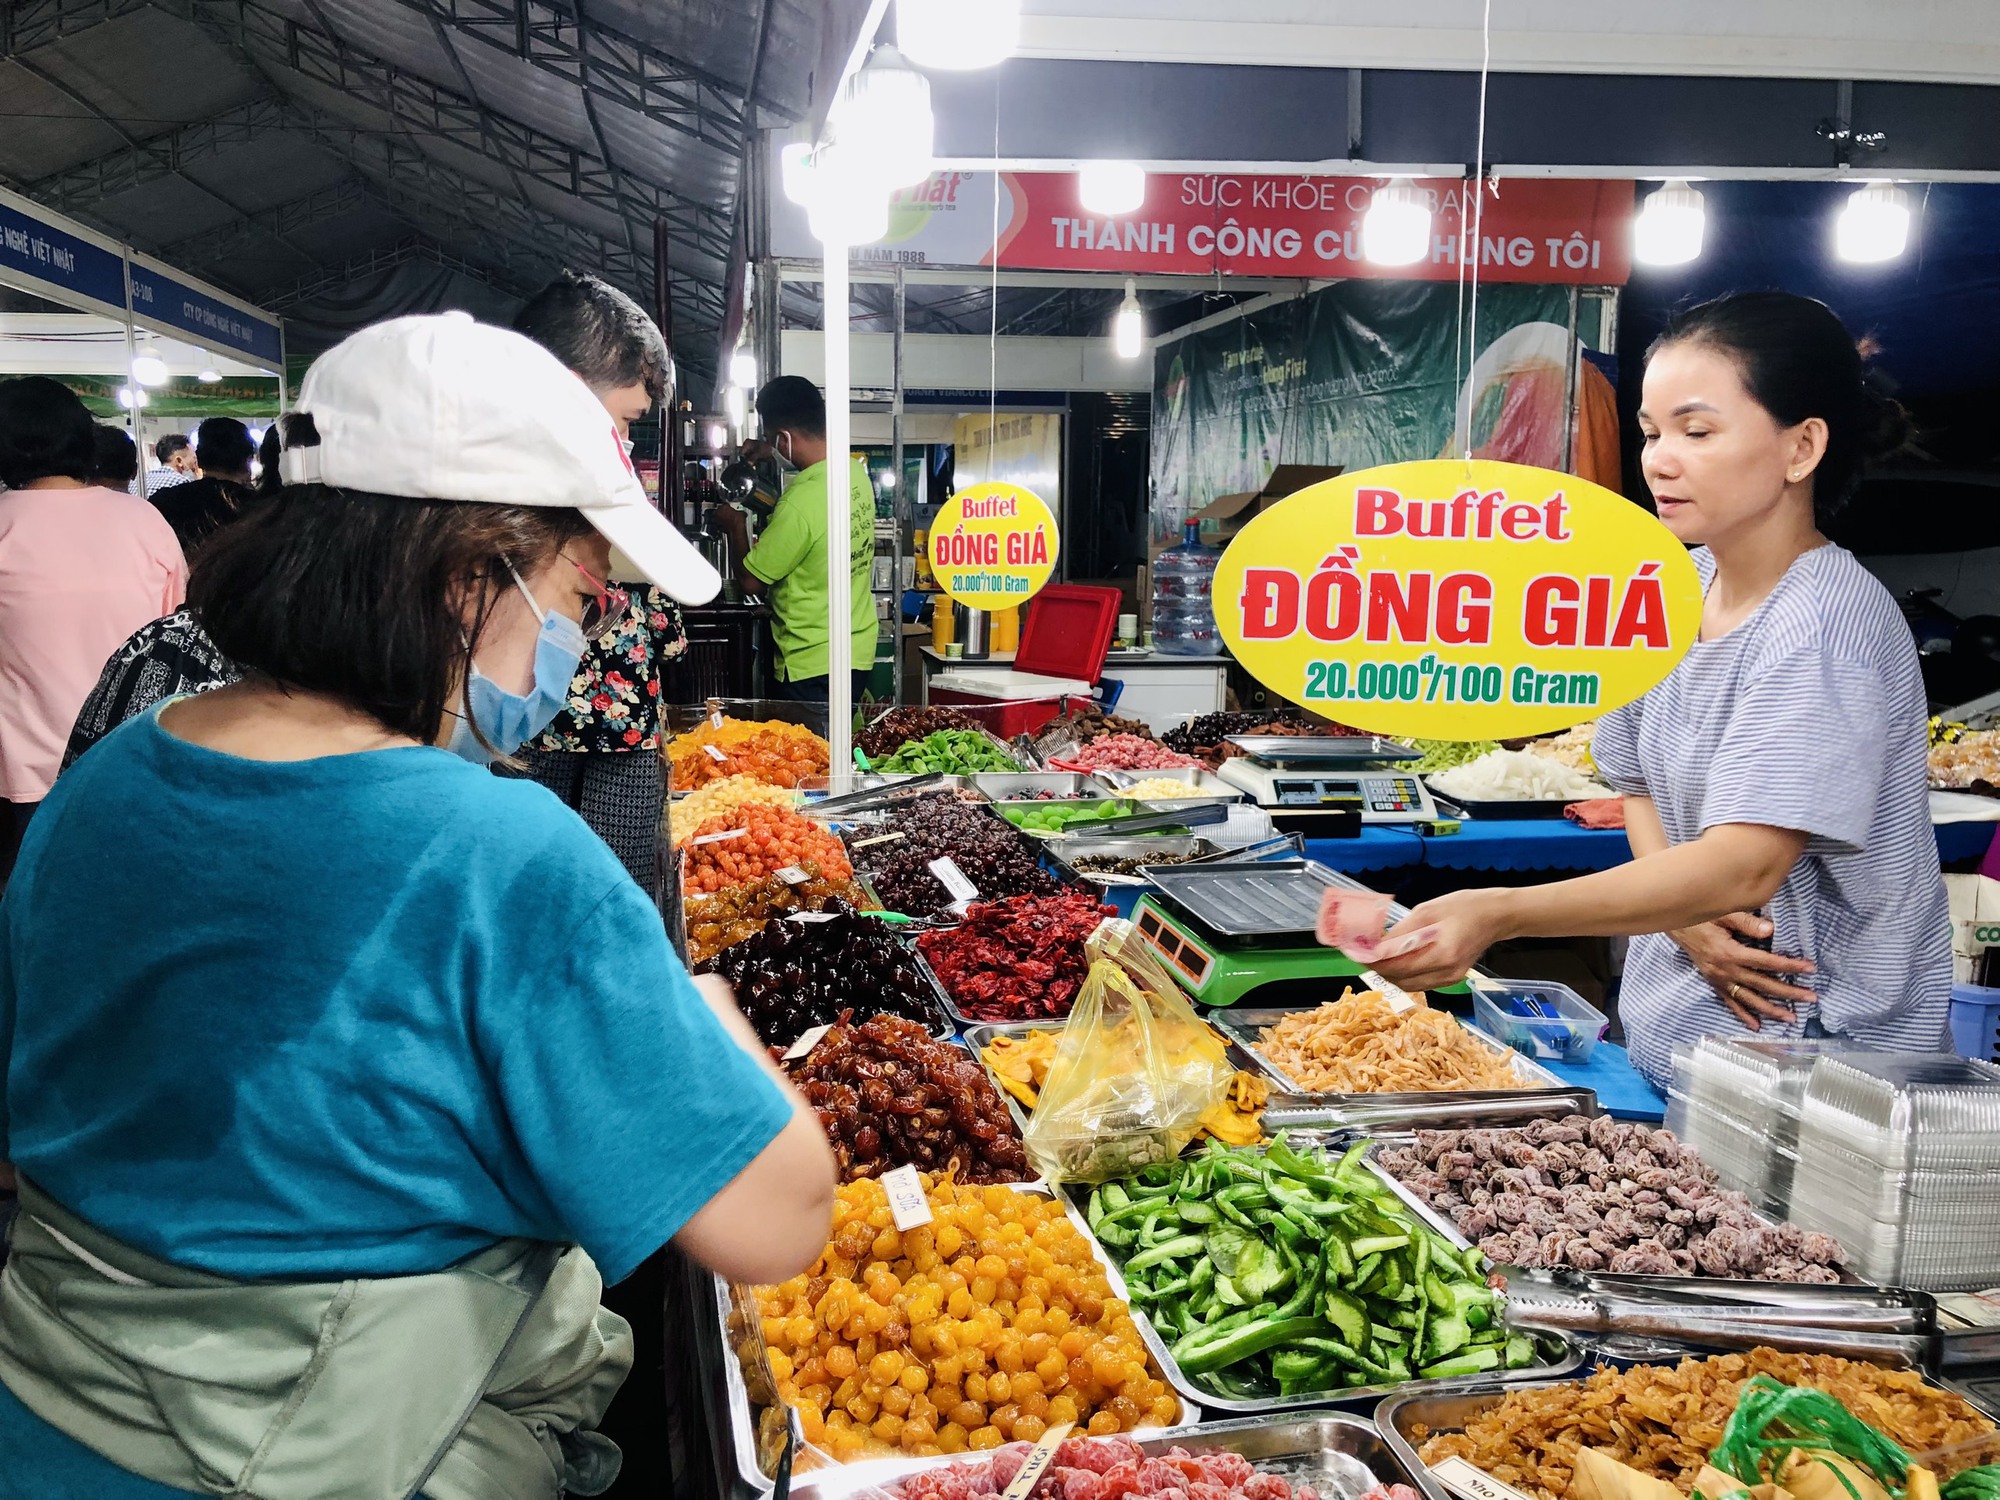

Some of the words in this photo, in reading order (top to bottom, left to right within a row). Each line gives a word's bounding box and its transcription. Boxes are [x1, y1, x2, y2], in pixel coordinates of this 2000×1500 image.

[1252, 175, 1335, 211] KHỎE
[4, 226, 30, 260] NGHỆ
[31, 237, 51, 267] VIỆT
[52, 246, 75, 276] NHẬT
[896, 250, 926, 263] 1988
[1187, 217, 1302, 260] CÔNG
[1431, 226, 1535, 267] HÚNG
[1545, 230, 1601, 270] TÔI
[961, 494, 1018, 519] Buffet
[1355, 489, 1572, 541] Buffet
[936, 523, 998, 566] ĐỒNG
[1006, 523, 1049, 566] GIÁ
[1004, 575, 1030, 592] Gram
[1240, 546, 1493, 645] ĐỒNG
[1523, 563, 1670, 649] GIÁ
[1511, 665, 1599, 705] Gram
